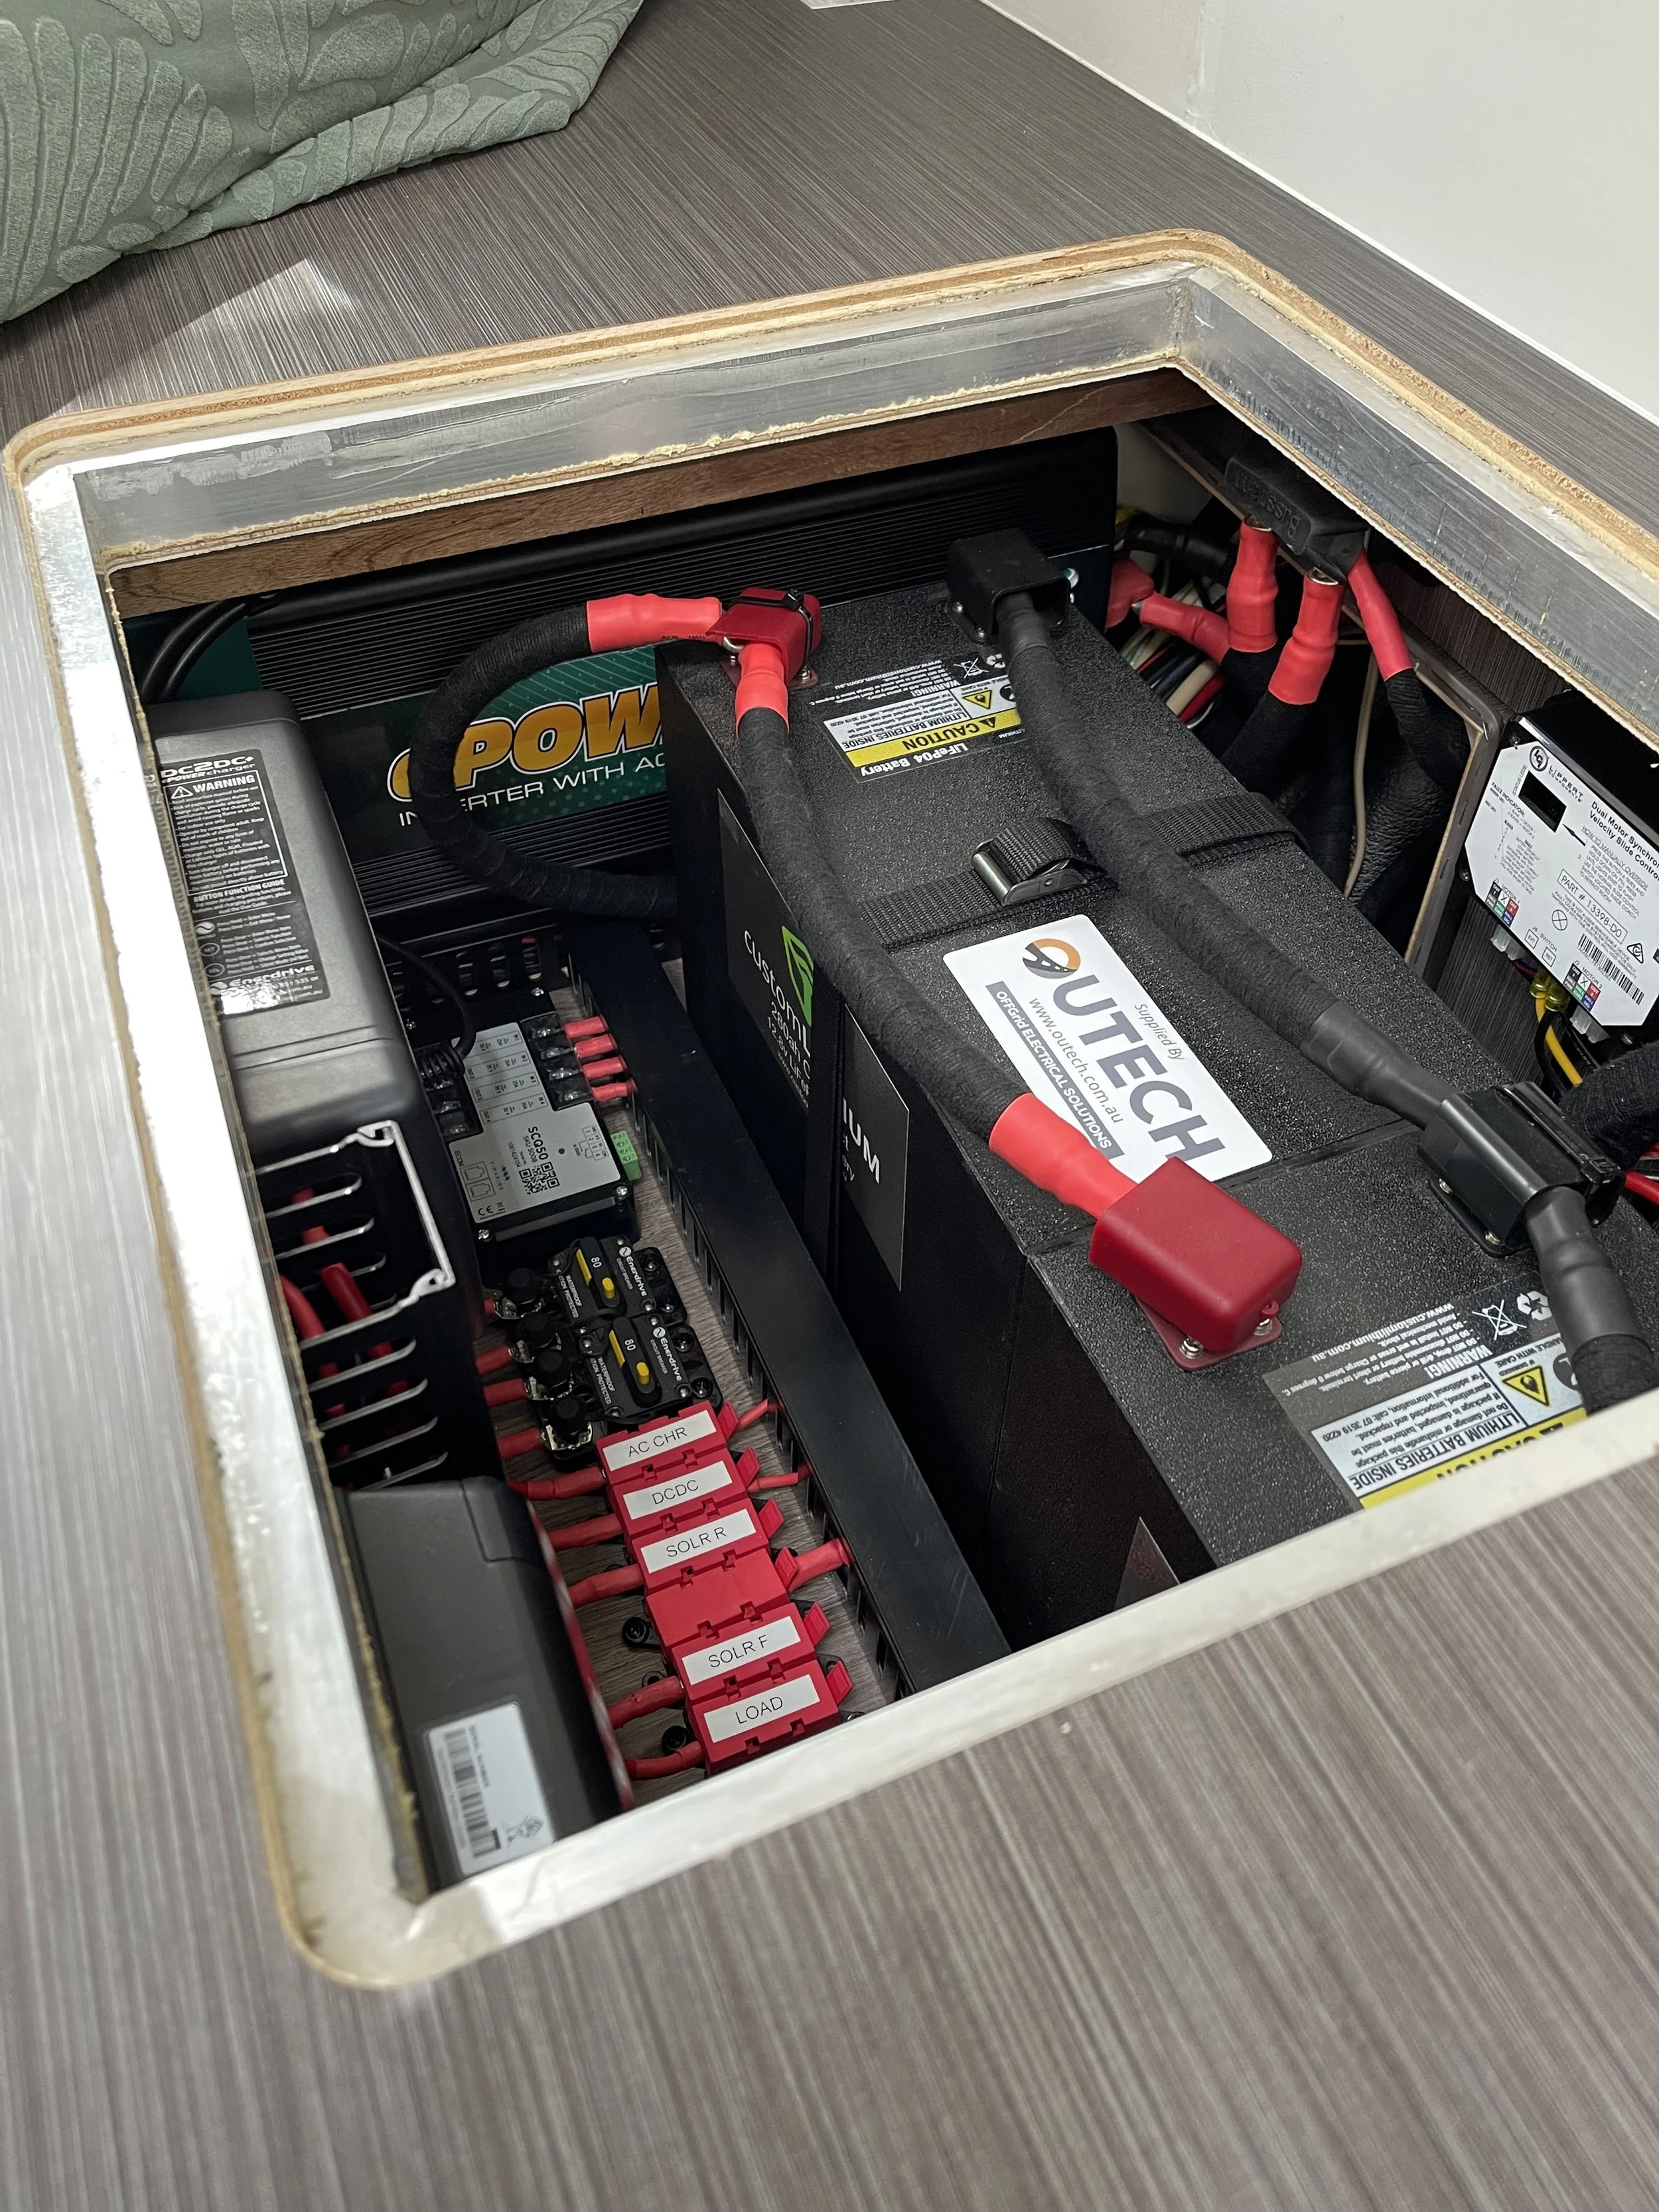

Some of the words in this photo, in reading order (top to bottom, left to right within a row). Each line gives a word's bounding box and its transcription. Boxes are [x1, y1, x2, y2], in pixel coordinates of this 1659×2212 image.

[909, 679, 961, 697] WARNING!
[927, 711, 967, 726] LITHIUM
[875, 722, 927, 740] BATTERIES
[901, 721, 981, 751] CAUTION
[841, 735, 875, 749] INSIDE
[553, 762, 624, 790] WITH
[857, 755, 912, 778] Battery
[192, 774, 255, 793] WARNING
[1591, 800, 1608, 820] Dual
[1607, 816, 1628, 839] Motor
[1587, 810, 1617, 841] Velocity
[1615, 835, 1634, 857] Slide
[192, 891, 224, 902] BUTTON
[223, 883, 261, 896] FUNCTION
[261, 878, 285, 889] GUIDE
[1560, 874, 1578, 895] PART
[1133, 1003, 1175, 1047] Supplied
[1167, 1047, 1185, 1063] By
[991, 990, 1033, 1029] OFFGrid
[1015, 1027, 1075, 1088] ELECTRICAL
[1056, 1086, 1118, 1149] SOLUTIONS
[1029, 997, 1123, 1124] www.outech.com.au
[521, 1135, 533, 1147] SKU
[524, 1125, 553, 1161] SCQ50
[589, 1256, 603, 1268] 80
[624, 1255, 649, 1297] Enerdrive
[561, 1274, 585, 1307] WATERPROOF
[561, 1289, 582, 1318] PROTECTED
[1310, 1301, 1457, 1364] www.customlithium.com.au
[623, 1338, 637, 1351] 80
[1514, 1347, 1538, 1359] WITH
[659, 1336, 684, 1382] Enerdrive
[1422, 1343, 1493, 1379] WARNING!
[1493, 1355, 1518, 1368] CARE
[594, 1357, 618, 1392] WATERPROOF
[1469, 1371, 1485, 1382] For
[594, 1372, 616, 1404] PROTECTED
[1432, 1376, 1472, 1396] additional
[1443, 1381, 1492, 1405] quarantined,
[1386, 1390, 1435, 1415] information,
[1407, 1399, 1447, 1420] inspected
[1459, 1393, 1494, 1412] package
[1481, 1406, 1498, 1417] not
[1494, 1402, 1509, 1412] Do
[1360, 1416, 1373, 1426] 07
[1371, 1409, 1390, 1422] call:
[1392, 1414, 1410, 1426] and
[1413, 1409, 1454, 1431] damaged,
[1451, 1410, 1484, 1429] damage
[1321, 1428, 1342, 1441] 4220
[1340, 1420, 1362, 1434] 3519
[1354, 1420, 1395, 1441] repacked.
[1381, 1426, 1417, 1444] batteries
[1442, 1424, 1454, 1433] or
[1463, 1411, 1520, 1442] LITHIUM
[628, 1439, 650, 1458] AC
[652, 1426, 688, 1448] CHR
[1360, 1439, 1384, 1453] must
[1403, 1428, 1445, 1449] mishandle
[1350, 1447, 1363, 1457] be
[1353, 1449, 1390, 1469] package
[1388, 1444, 1406, 1455] this
[1393, 1433, 1467, 1471] BATTERIES
[1348, 1461, 1397, 1490] INSIDE
[651, 1479, 699, 1505] DCDC
[665, 1531, 712, 1558] SOLR
[714, 1526, 727, 1540] R
[707, 1640, 756, 1668] SOLR
[758, 1634, 768, 1649] F
[734, 1696, 784, 1725] LOAD
